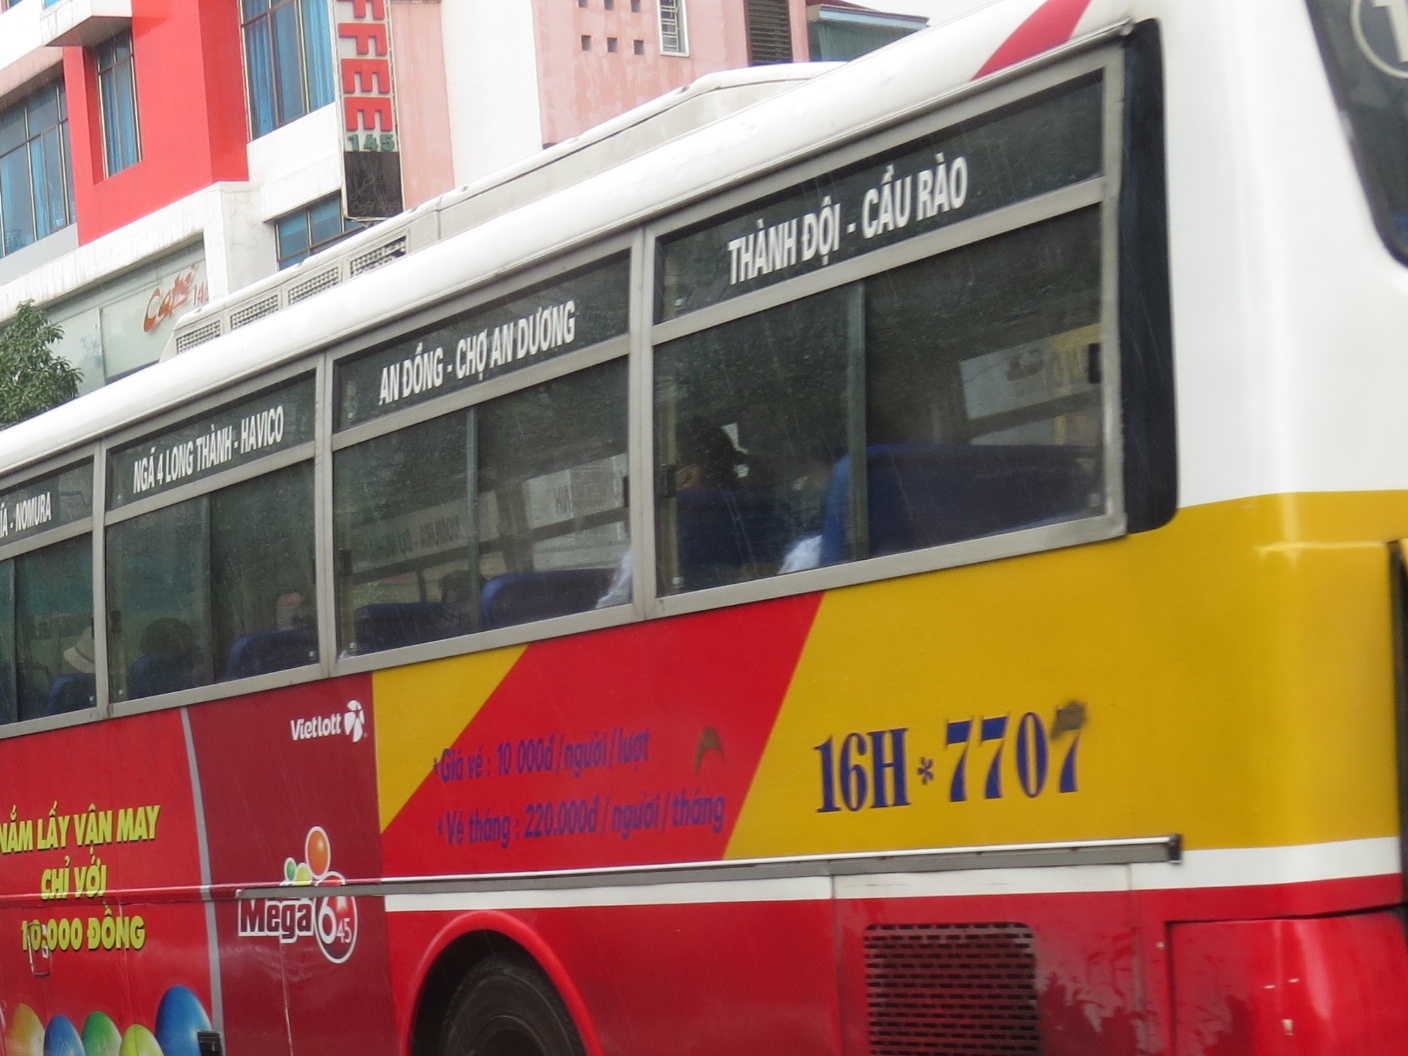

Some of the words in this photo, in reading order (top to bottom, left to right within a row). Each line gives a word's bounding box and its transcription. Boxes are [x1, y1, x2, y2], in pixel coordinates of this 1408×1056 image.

[347, 134, 395, 151] 145
[728, 218, 798, 285] THÀNH
[800, 195, 840, 266] ĐỘI
[862, 164, 912, 240] CẦU
[917, 152, 968, 221] RÀO
[378, 364, 400, 406] AN
[402, 342, 444, 398] ĐỒNG
[455, 328, 489, 381] CHỢ
[490, 322, 514, 368] AN
[517, 300, 576, 360] DƯƠNG
[157, 453, 163, 486] 4
[165, 440, 194, 484] LONG
[196, 424, 233, 472] THÀNH
[240, 405, 284, 454] HAVICO
[15, 491, 51, 532] NOMURA
[290, 712, 342, 741] Vietlott
[37, 800, 71, 850] LẤY
[74, 803, 113, 855] VẬN
[116, 805, 160, 843] MAY
[41, 855, 70, 901] CHỈ
[74, 854, 107, 899] VỚI
[87, 901, 146, 950] ĐỒNG
[238, 896, 314, 943] Mega
